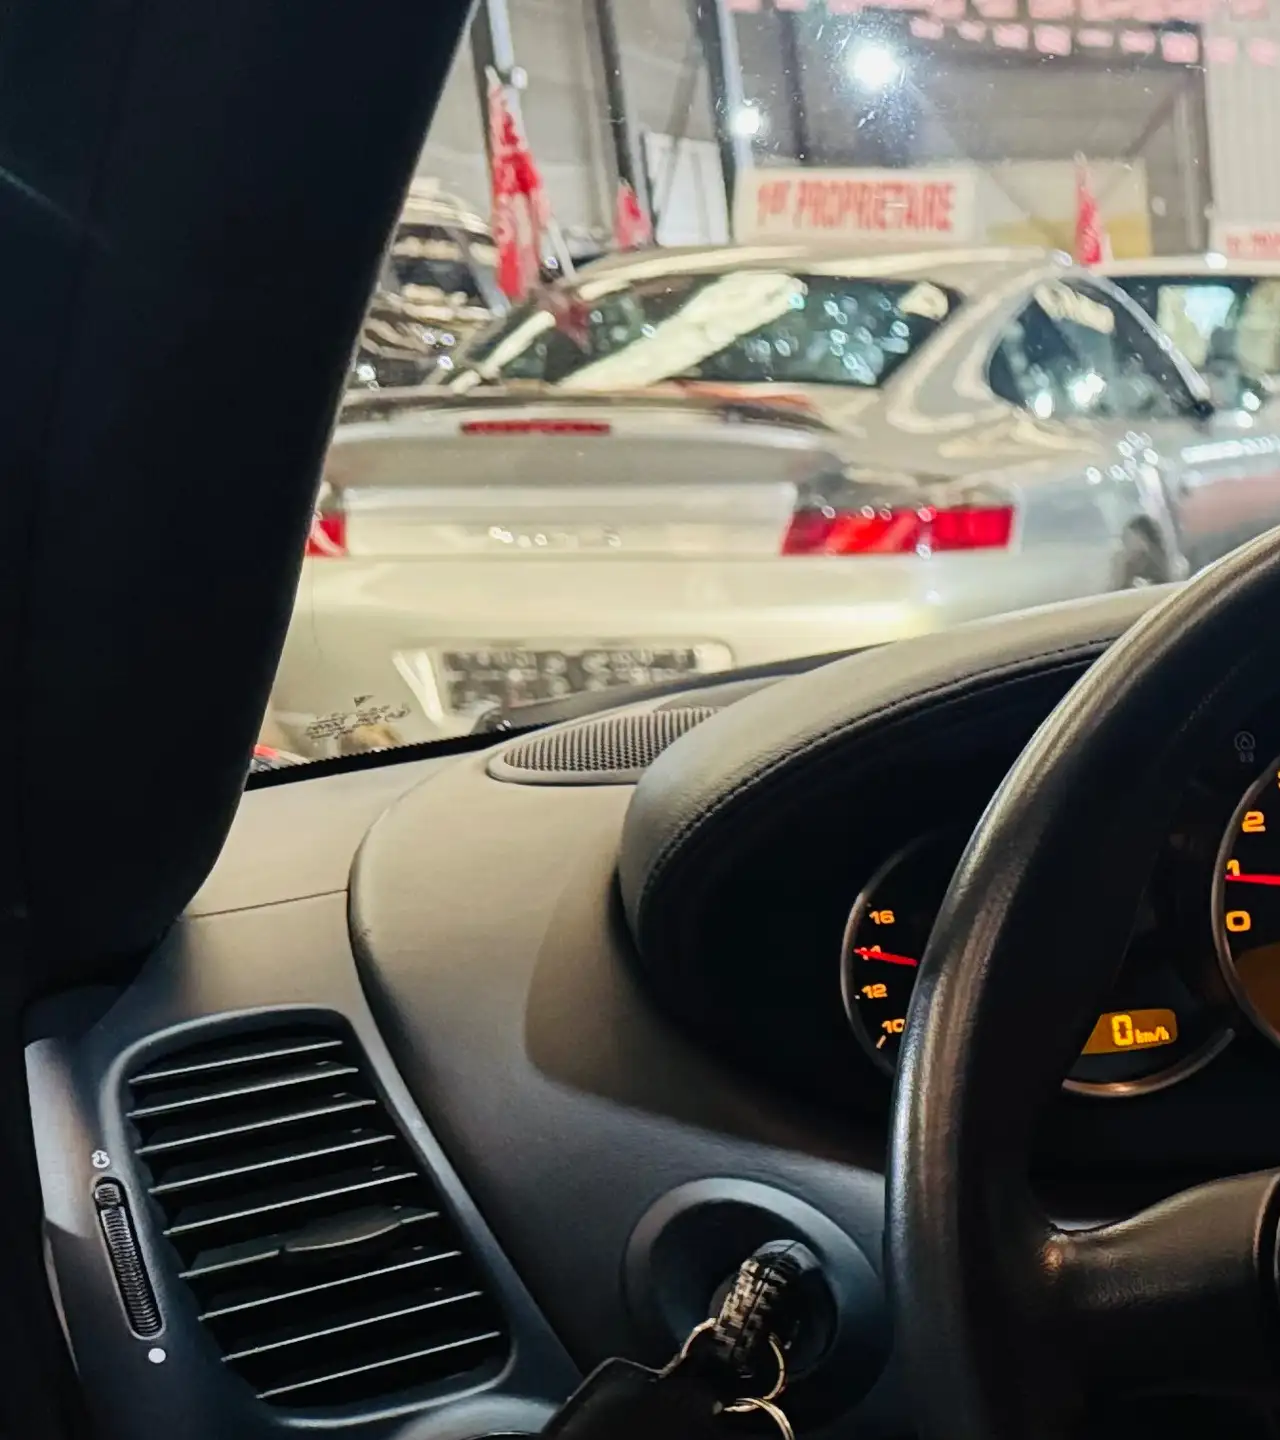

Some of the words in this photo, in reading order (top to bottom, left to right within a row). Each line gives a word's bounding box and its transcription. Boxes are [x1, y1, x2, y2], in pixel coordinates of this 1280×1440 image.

[1242, 811, 1266, 832] 2
[869, 909, 895, 925] 16
[1226, 911, 1251, 932] 0
[861, 983, 888, 999] 12
[882, 1018, 905, 1034] 10
[1112, 1014, 1134, 1046] 0
